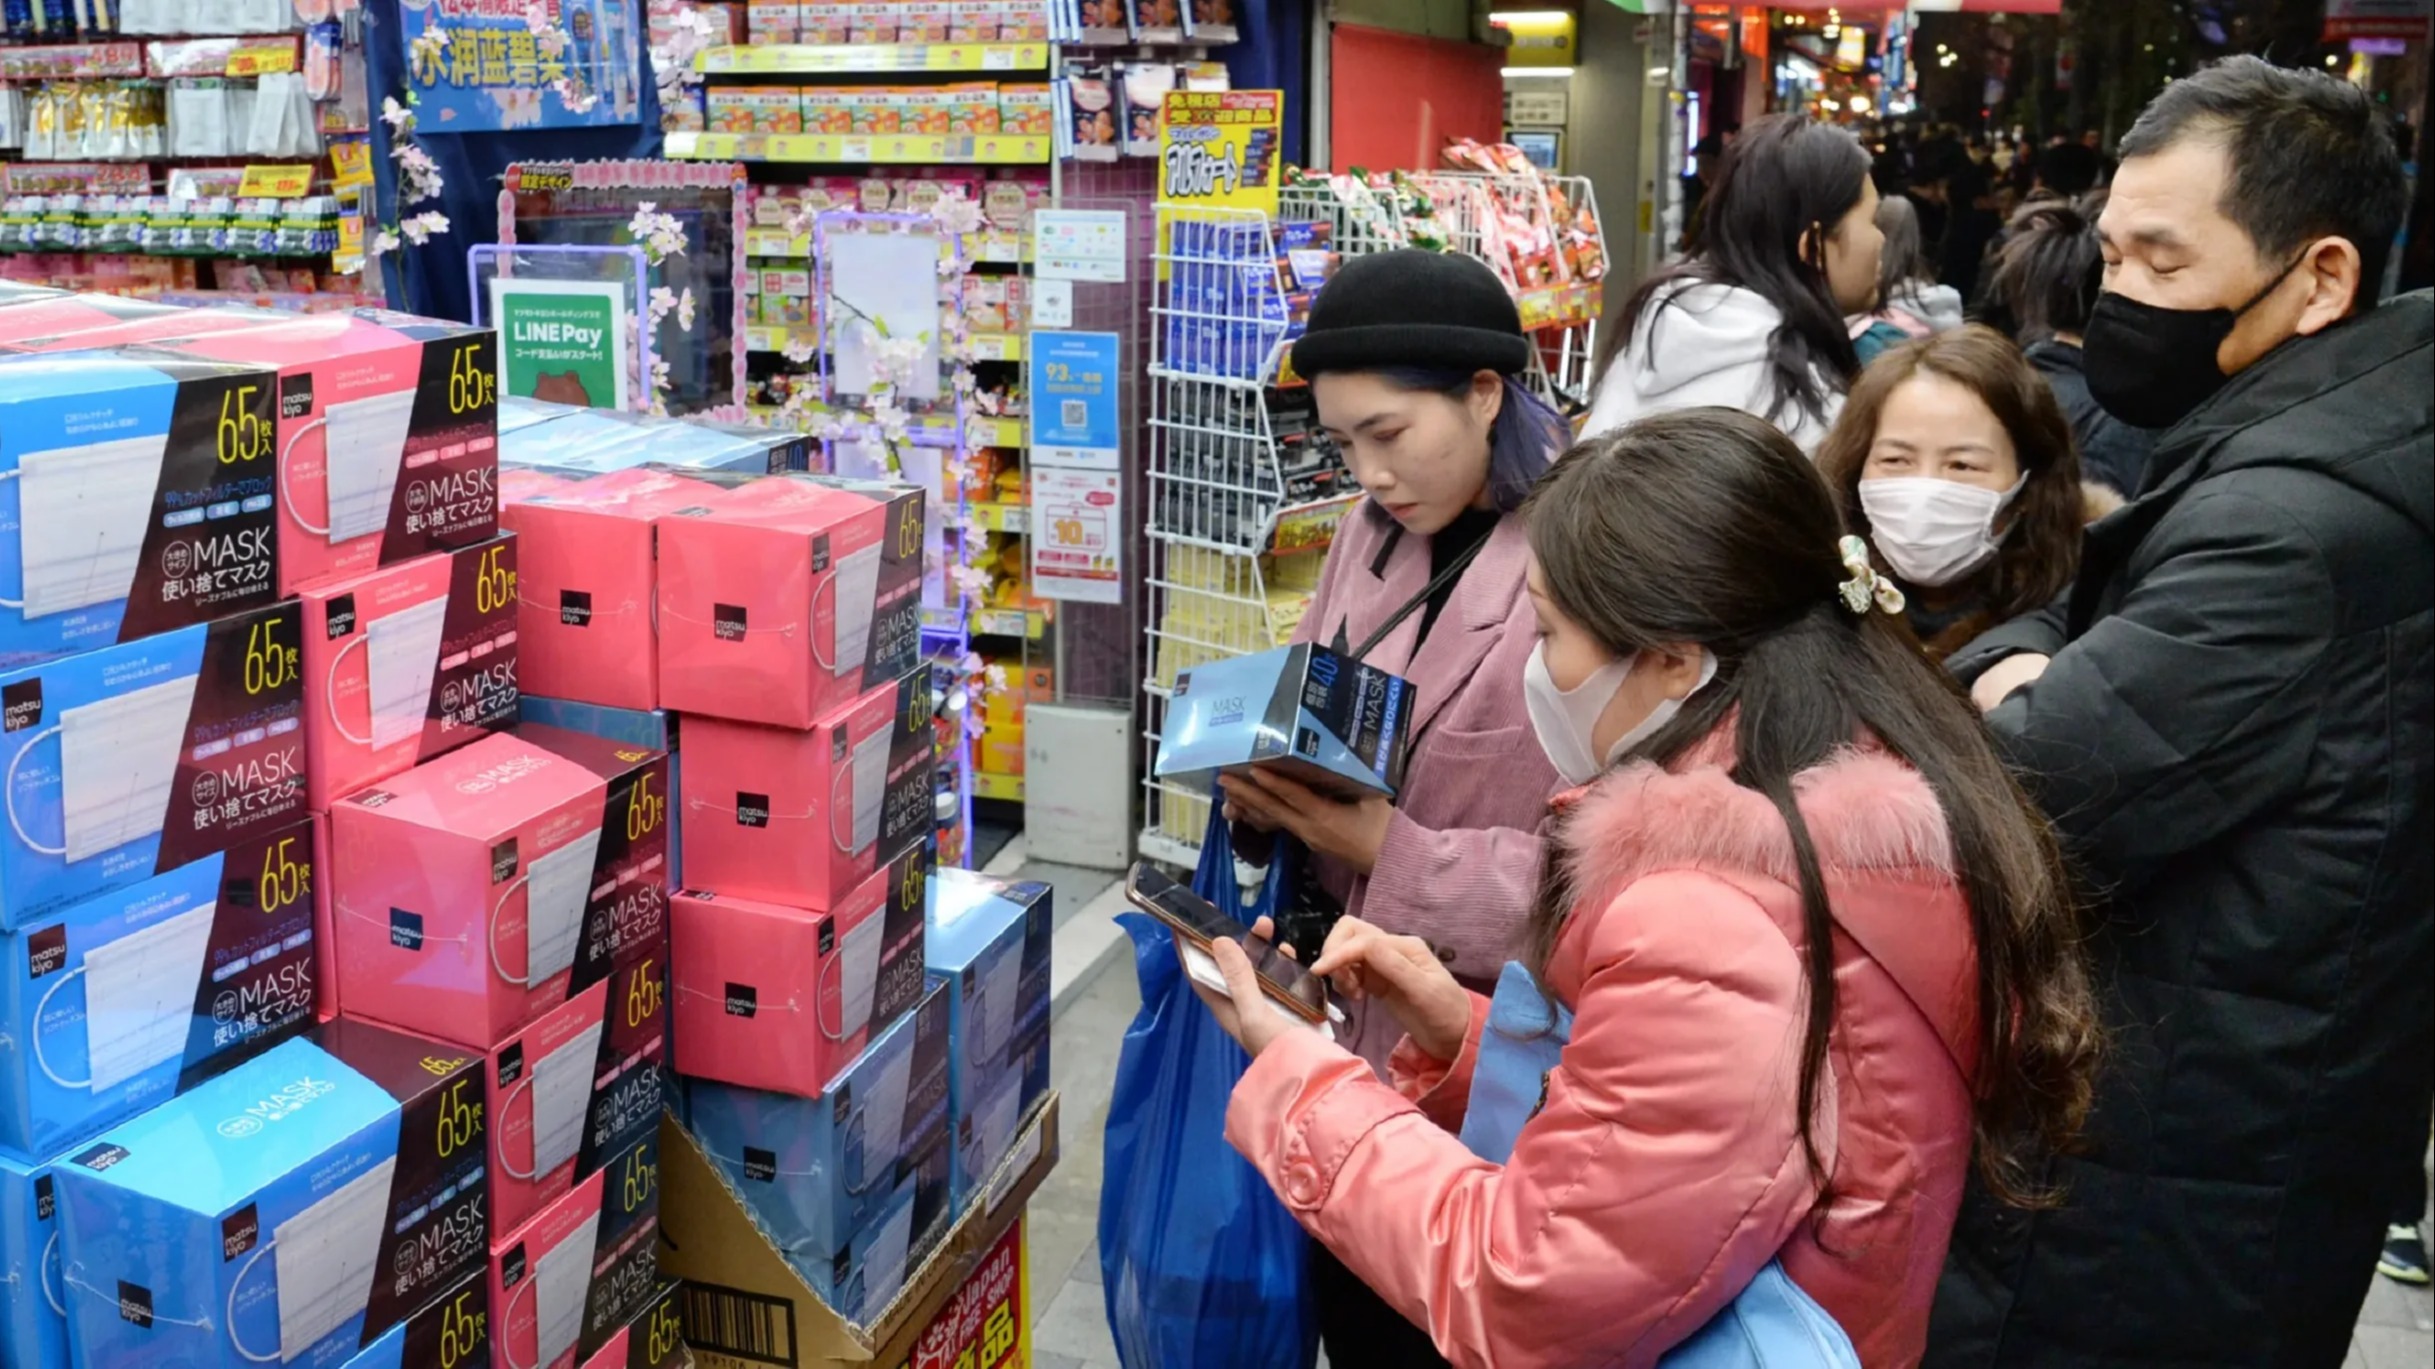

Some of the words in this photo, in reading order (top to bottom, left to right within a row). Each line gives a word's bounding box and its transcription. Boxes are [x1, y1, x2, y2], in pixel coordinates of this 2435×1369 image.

[514, 322, 561, 342] LINE
[562, 324, 602, 349] Pay
[282, 391, 312, 405] matsu
[450, 345, 483, 414] 65
[483, 373, 494, 405] 枚入
[217, 386, 259, 463] 65
[260, 420, 273, 455] 枚入
[283, 403, 302, 418] kiyo
[430, 465, 494, 506] MASK
[405, 495, 494, 535] 使い捨てマスク
[900, 498, 918, 559] 65
[194, 525, 271, 571] MASK
[162, 560, 270, 602] 使い捨てマスク
[477, 546, 507, 614] 65
[328, 611, 355, 626] matsu
[329, 625, 345, 640] kiyo
[561, 604, 591, 615] matsu
[561, 613, 580, 625] kiyo
[715, 618, 746, 631] matsu
[245, 618, 284, 694] 65
[285, 648, 298, 681] 枚入
[715, 629, 735, 640] kiyo
[462, 657, 517, 704] MASK
[908, 673, 926, 733] 65
[1363, 676, 1387, 730] MASK
[5, 699, 42, 717] matsu
[5, 714, 28, 732] kiyo
[441, 687, 517, 733] 使い捨てマスク
[222, 746, 297, 798] MASK
[898, 769, 929, 810] MASK
[193, 779, 297, 831] 使い捨てマスク
[627, 772, 655, 840] 65
[738, 806, 768, 819] matsu
[739, 814, 757, 825] kiyo
[260, 837, 298, 913] 65
[298, 864, 311, 896] 枚入
[902, 852, 919, 911] 65
[608, 881, 662, 932] MASK
[31, 944, 65, 963] matsu
[392, 925, 423, 939] matsu
[392, 934, 412, 947] kiyo
[588, 909, 661, 963] 使い捨てマスク
[31, 959, 53, 976] kiyo
[240, 957, 311, 1014] MASK
[627, 959, 654, 1027] 65
[214, 989, 311, 1047] 使い捨てマスク
[245, 1076, 327, 1118] MASK
[613, 1060, 661, 1115] MASK
[437, 1079, 471, 1157] 65
[624, 1144, 649, 1213] 65
[225, 1223, 258, 1247] matsu
[420, 1193, 484, 1260] MASK
[224, 1241, 247, 1260] kiyo
[394, 1224, 484, 1297] 使い捨てマスク
[611, 1240, 656, 1298] MASK
[963, 1246, 1010, 1315] Japan
[121, 1298, 153, 1316] matsu
[121, 1308, 141, 1323] kiyo
[440, 1291, 475, 1369] 65
[649, 1299, 672, 1365] 65
